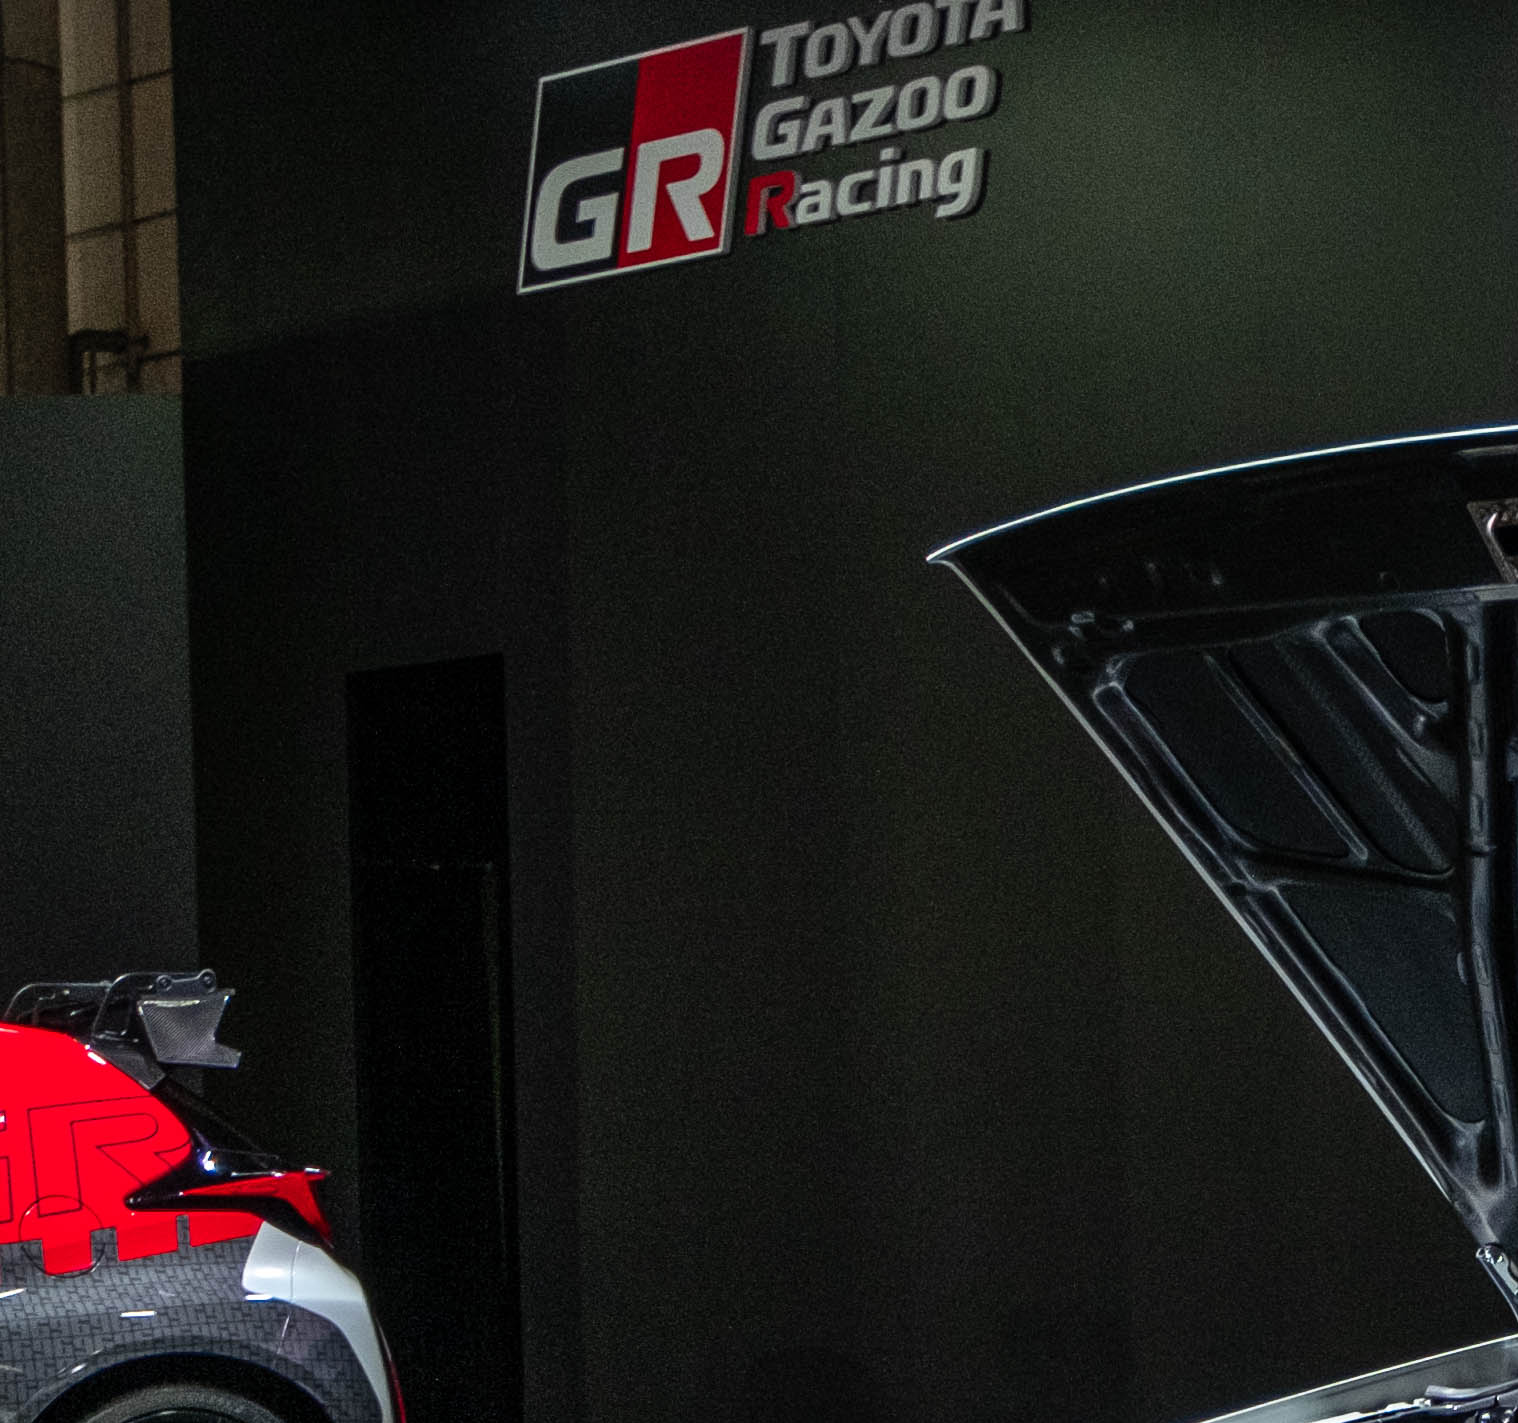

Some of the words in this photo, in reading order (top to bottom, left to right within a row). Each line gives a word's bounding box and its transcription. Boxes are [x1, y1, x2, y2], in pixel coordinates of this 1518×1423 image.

[760, 0, 1019, 87] TOYOTA
[751, 64, 995, 160] GAZOO
[531, 128, 725, 271] GR
[744, 147, 985, 235] Racing
